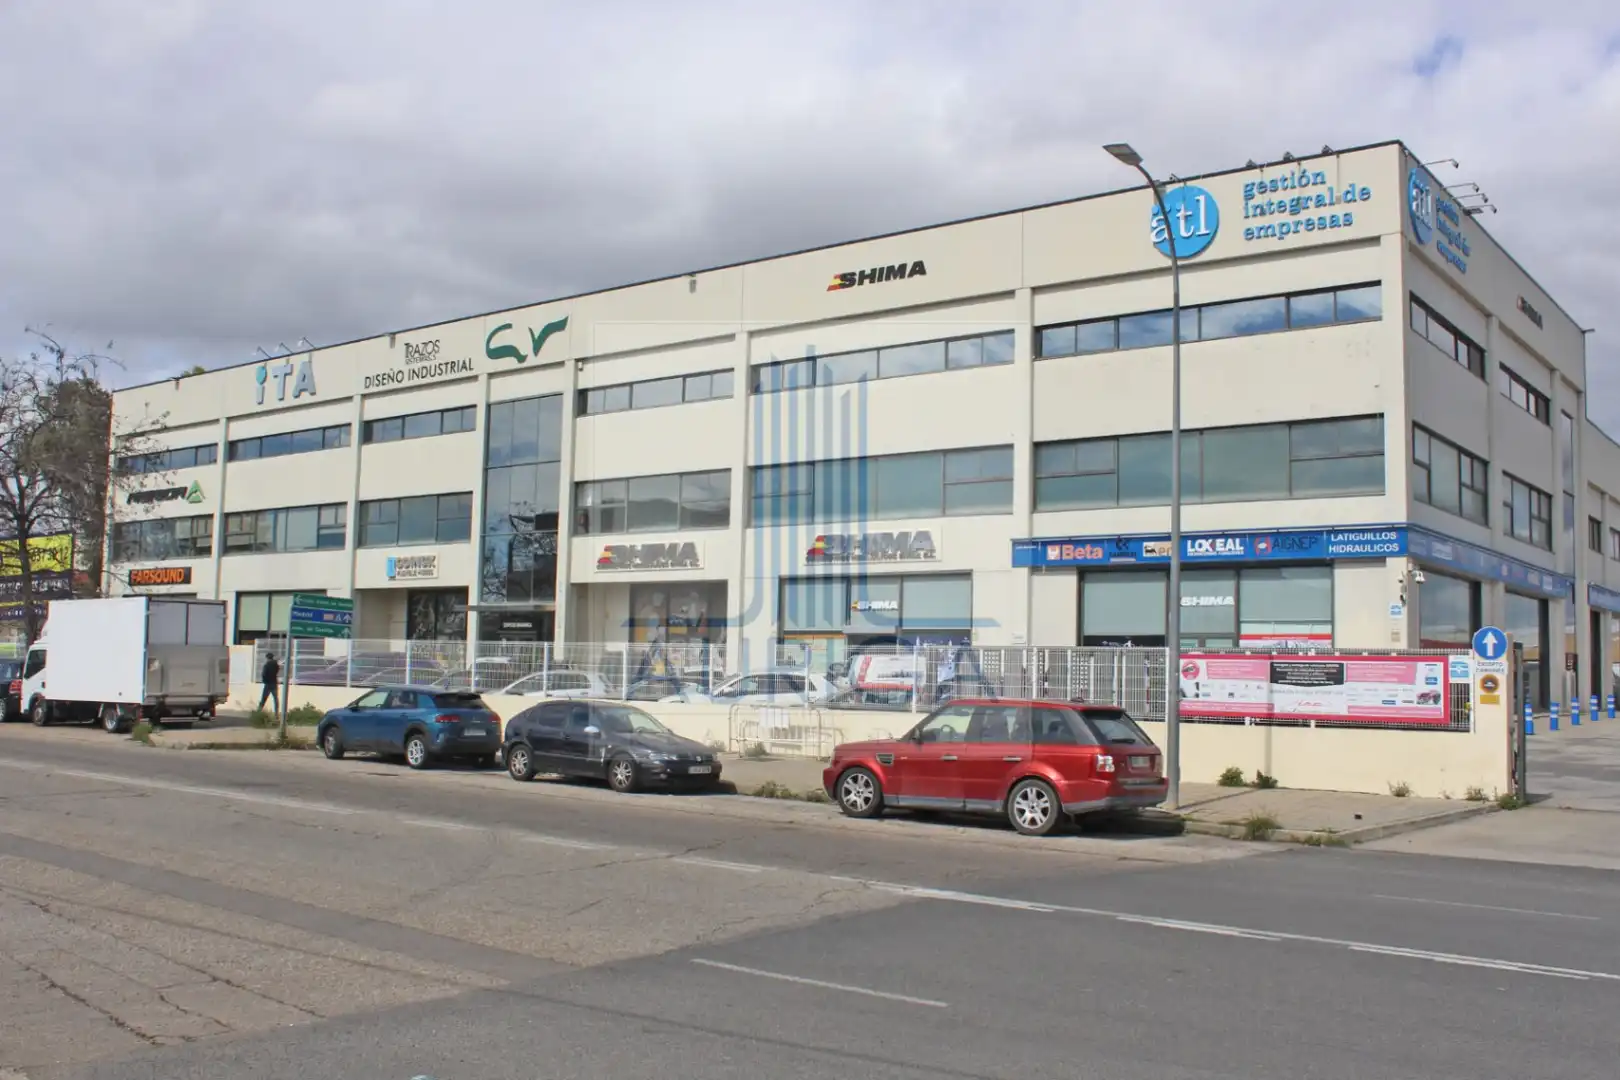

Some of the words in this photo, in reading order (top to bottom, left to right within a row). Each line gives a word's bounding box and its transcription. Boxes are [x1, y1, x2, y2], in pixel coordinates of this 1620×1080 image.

[1243, 168, 1326, 200] gestión
[1243, 187, 1336, 219] integral
[1342, 183, 1372, 204] de
[1243, 211, 1354, 240] empresas
[827, 260, 926, 291] SHIMA
[404, 339, 440, 358] TRAZOS
[364, 367, 404, 389] DISEÑO
[408, 357, 474, 381] INDUSTRIAL
[1330, 531, 1397, 542] LATIGUILLOS
[1062, 544, 1103, 560] Beta
[1328, 543, 1399, 553] HIDRAULICOS
[131, 569, 185, 583] FARSOUND
[1180, 596, 1235, 606] SHIMA
